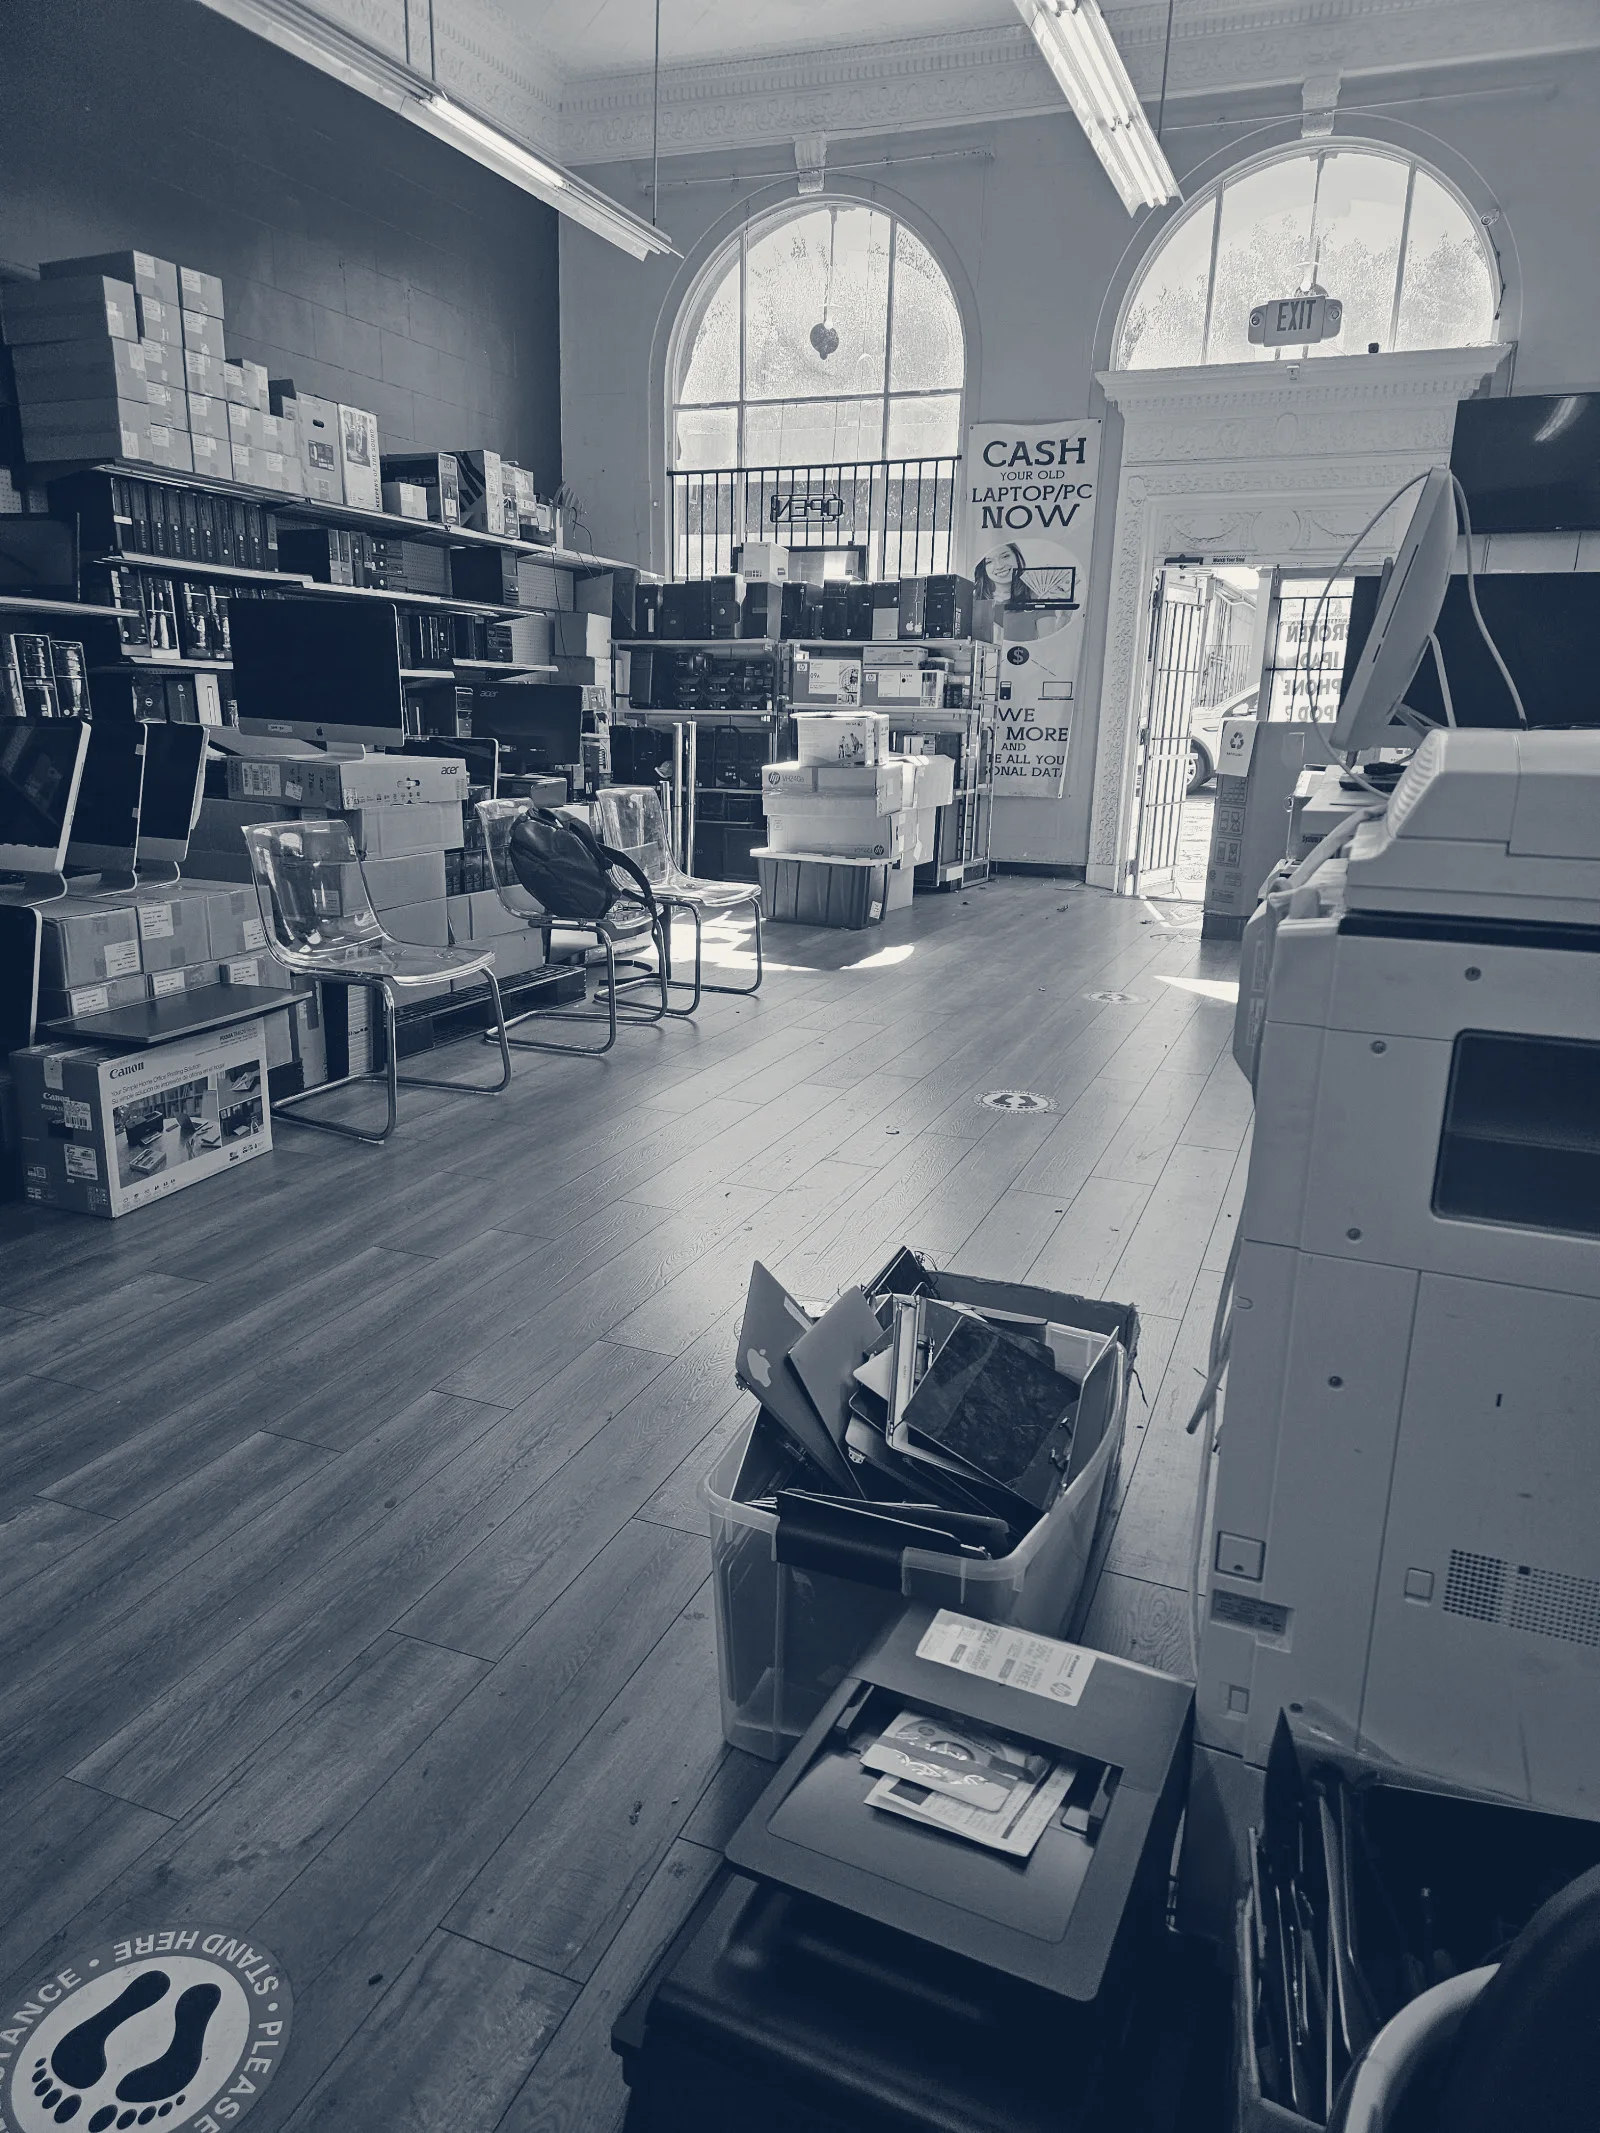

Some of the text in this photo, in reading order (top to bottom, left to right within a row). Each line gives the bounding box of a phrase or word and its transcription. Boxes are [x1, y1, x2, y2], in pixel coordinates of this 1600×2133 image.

[1277, 300, 1316, 331] EXIT
[983, 437, 1086, 467] CASH
[1001, 470, 1065, 481] YOUR OLD
[972, 484, 1093, 502] LAPTOP/PC
[982, 503, 1080, 529] NOW
[479, 689, 499, 698] acer
[998, 708, 1036, 722] WE
[1006, 727, 1069, 742] MORE
[1001, 743, 1026, 751] AND
[1006, 754, 1030, 764] ALL
[1036, 755, 1065, 766] YOU
[441, 766, 459, 775] acer
[769, 772, 780, 785] hp
[110, 1061, 145, 1080] Canon
[111, 1063, 202, 1098] Your Simple Home Office Printing Solution
[114, 1930, 279, 1995] STAND HERE
[194, 2020, 283, 2133] PLEASE
